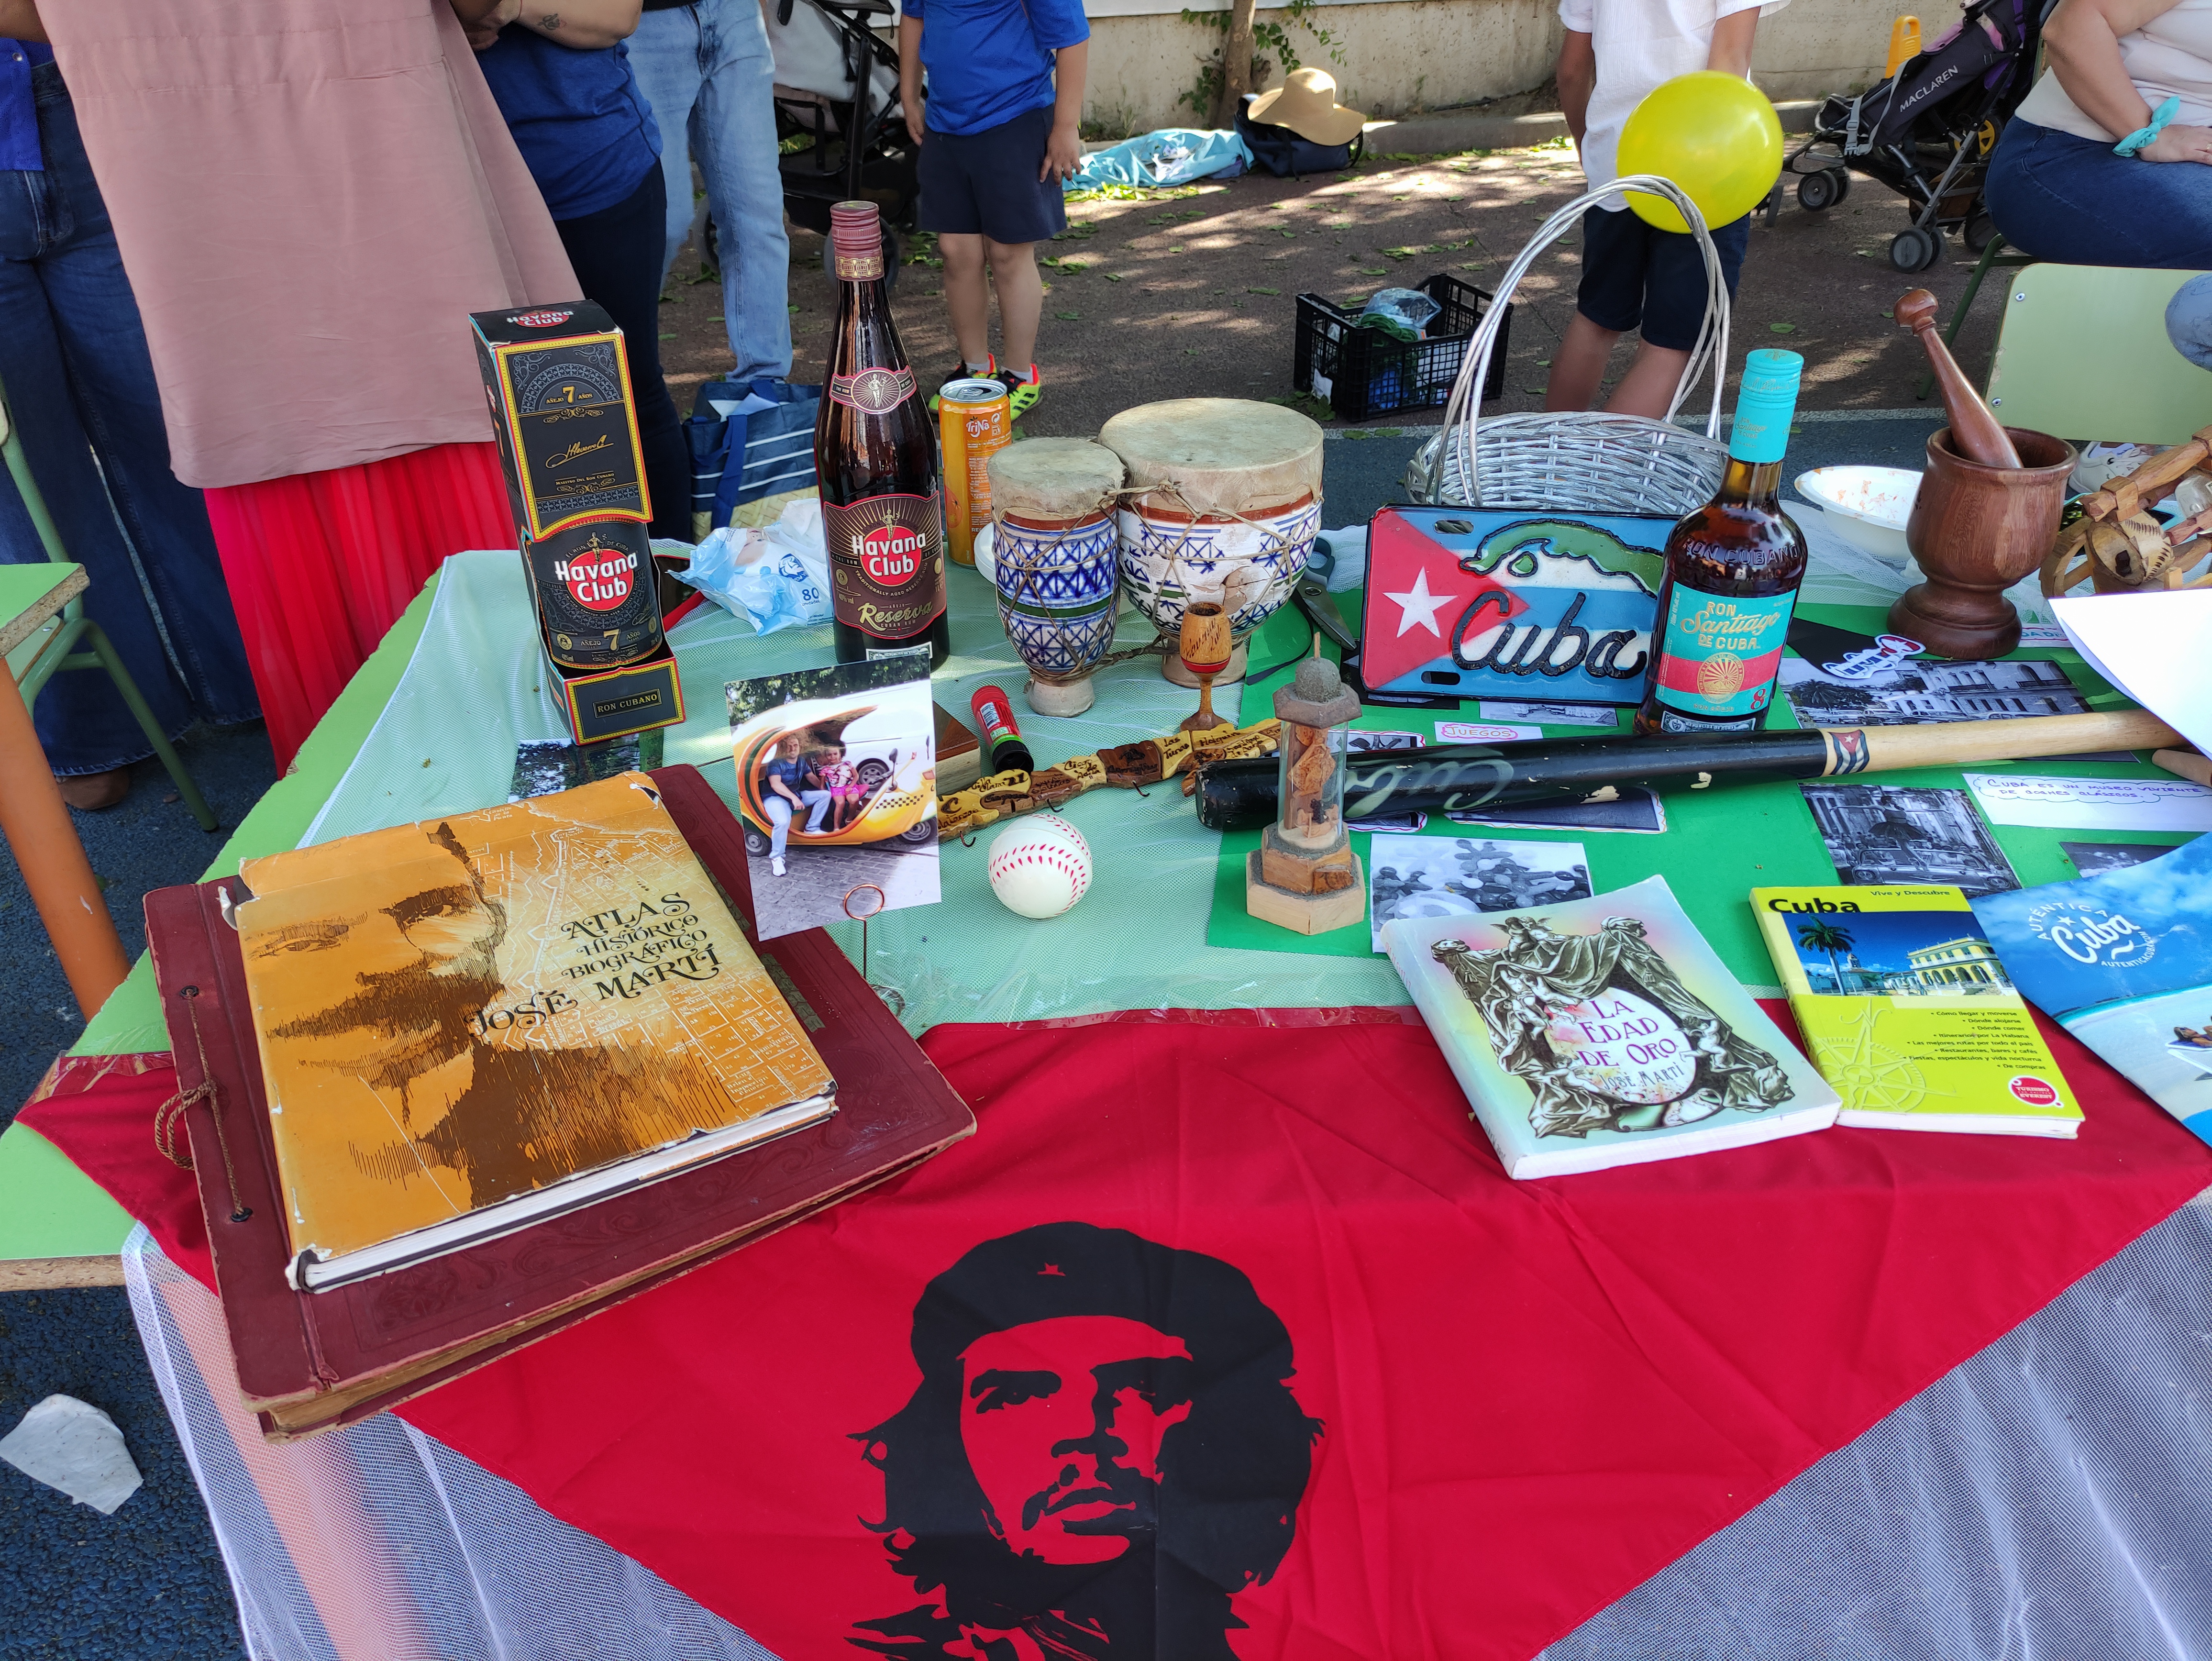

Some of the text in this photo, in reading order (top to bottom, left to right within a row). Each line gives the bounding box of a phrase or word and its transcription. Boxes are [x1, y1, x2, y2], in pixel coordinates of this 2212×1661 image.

[1900, 65, 1958, 112] MACLAREN
[507, 311, 574, 323] Havana
[524, 317, 563, 326] Club
[563, 386, 575, 403] 7
[1735, 421, 1767, 432] Santiago
[573, 544, 586, 553] RON
[616, 543, 629, 552] CUBA
[852, 532, 927, 556] Havana
[1724, 545, 1798, 565] CUBANO
[555, 552, 638, 582] Havana
[869, 554, 914, 576] Club
[577, 577, 627, 602] Club
[802, 587, 819, 601] 80
[855, 569, 889, 597] TRADITIONALLY
[857, 601, 933, 631] Reserva
[1707, 601, 1736, 617] RON
[1681, 610, 1781, 636] Santiago
[603, 629, 620, 652] 7
[626, 631, 641, 640] AÑOS
[1452, 590, 1647, 679] Cuba
[1698, 634, 1757, 651] DE CUBA
[597, 694, 657, 713] RON CUBANO
[1750, 689, 1767, 709] 8
[1164, 737, 1181, 747] Las
[1446, 726, 1512, 737] JUEGOS
[1163, 743, 1190, 759] Tunas
[1987, 779, 2029, 787] CUBA
[561, 892, 690, 940] ATLAS
[1768, 897, 1861, 913] Cuba
[2028, 902, 2109, 941] AUTÉNTICA
[577, 915, 698, 957] HISTÓRICO
[2051, 914, 2142, 964] Cuba
[561, 930, 707, 979] BIOGRÁFICO
[464, 943, 723, 1038] JOSÉ MARTÍ
[1589, 999, 1636, 1019] LA
[1579, 1019, 1660, 1044] EDAD
[1581, 1041, 1681, 1068] DE ORO
[1600, 1062, 1685, 1091] JOSÉ MARTÍ
